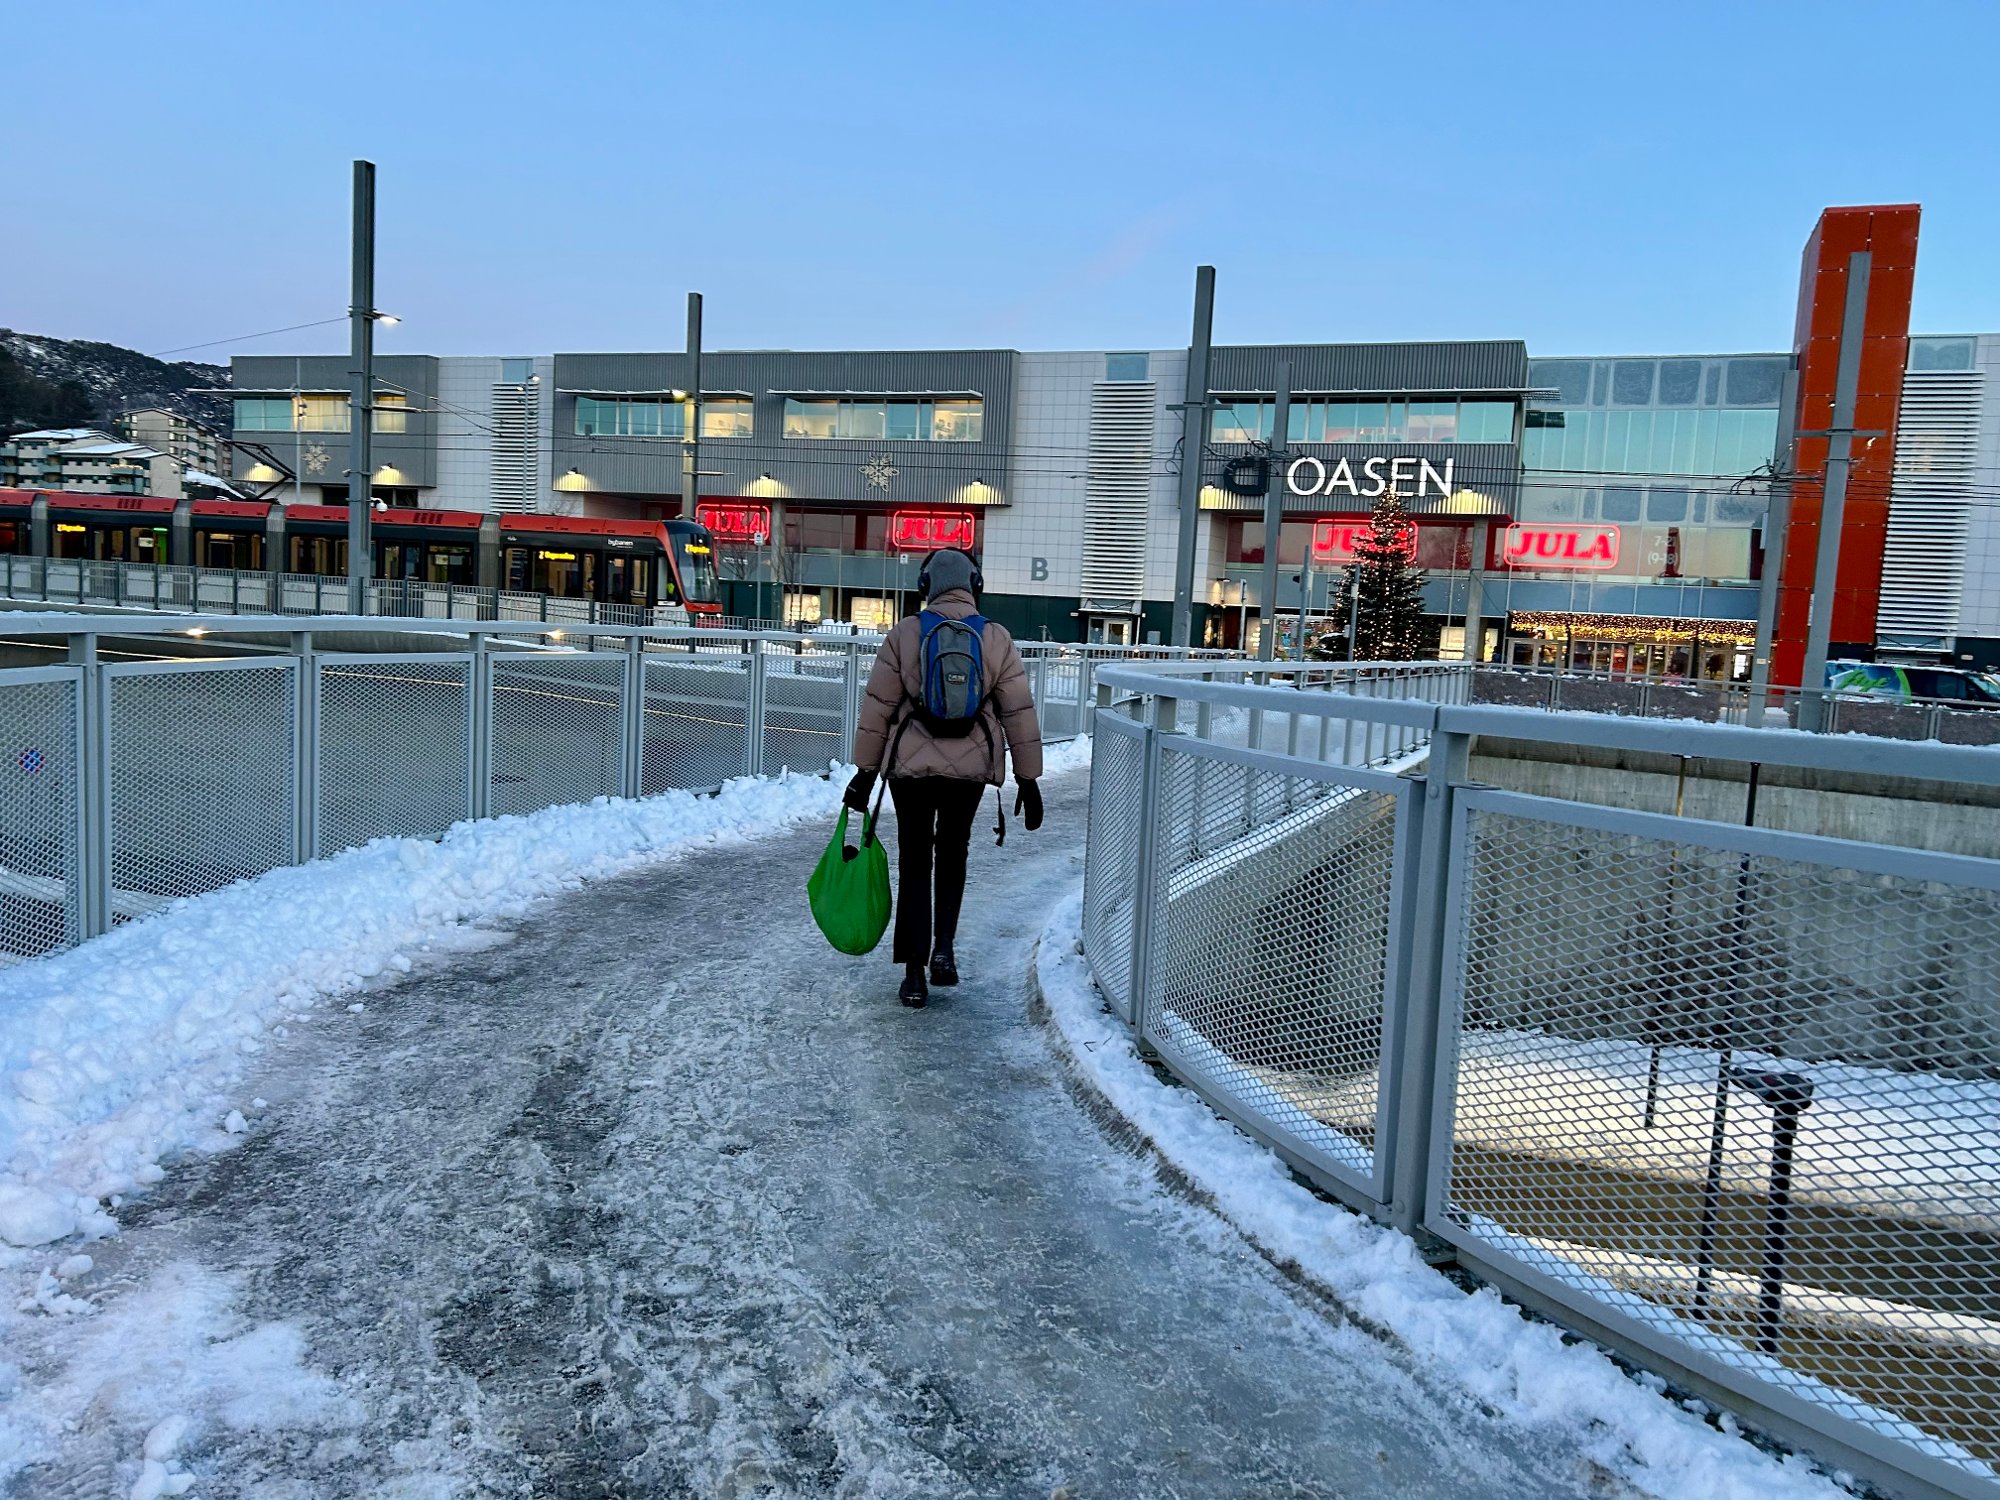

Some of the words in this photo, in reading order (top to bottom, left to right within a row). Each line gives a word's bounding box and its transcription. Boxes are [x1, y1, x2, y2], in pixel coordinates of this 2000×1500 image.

[1287, 456, 1454, 497] OASEN
[896, 517, 970, 542] JULA
[1508, 531, 1613, 560] JULA
[1031, 557, 1049, 581] B
